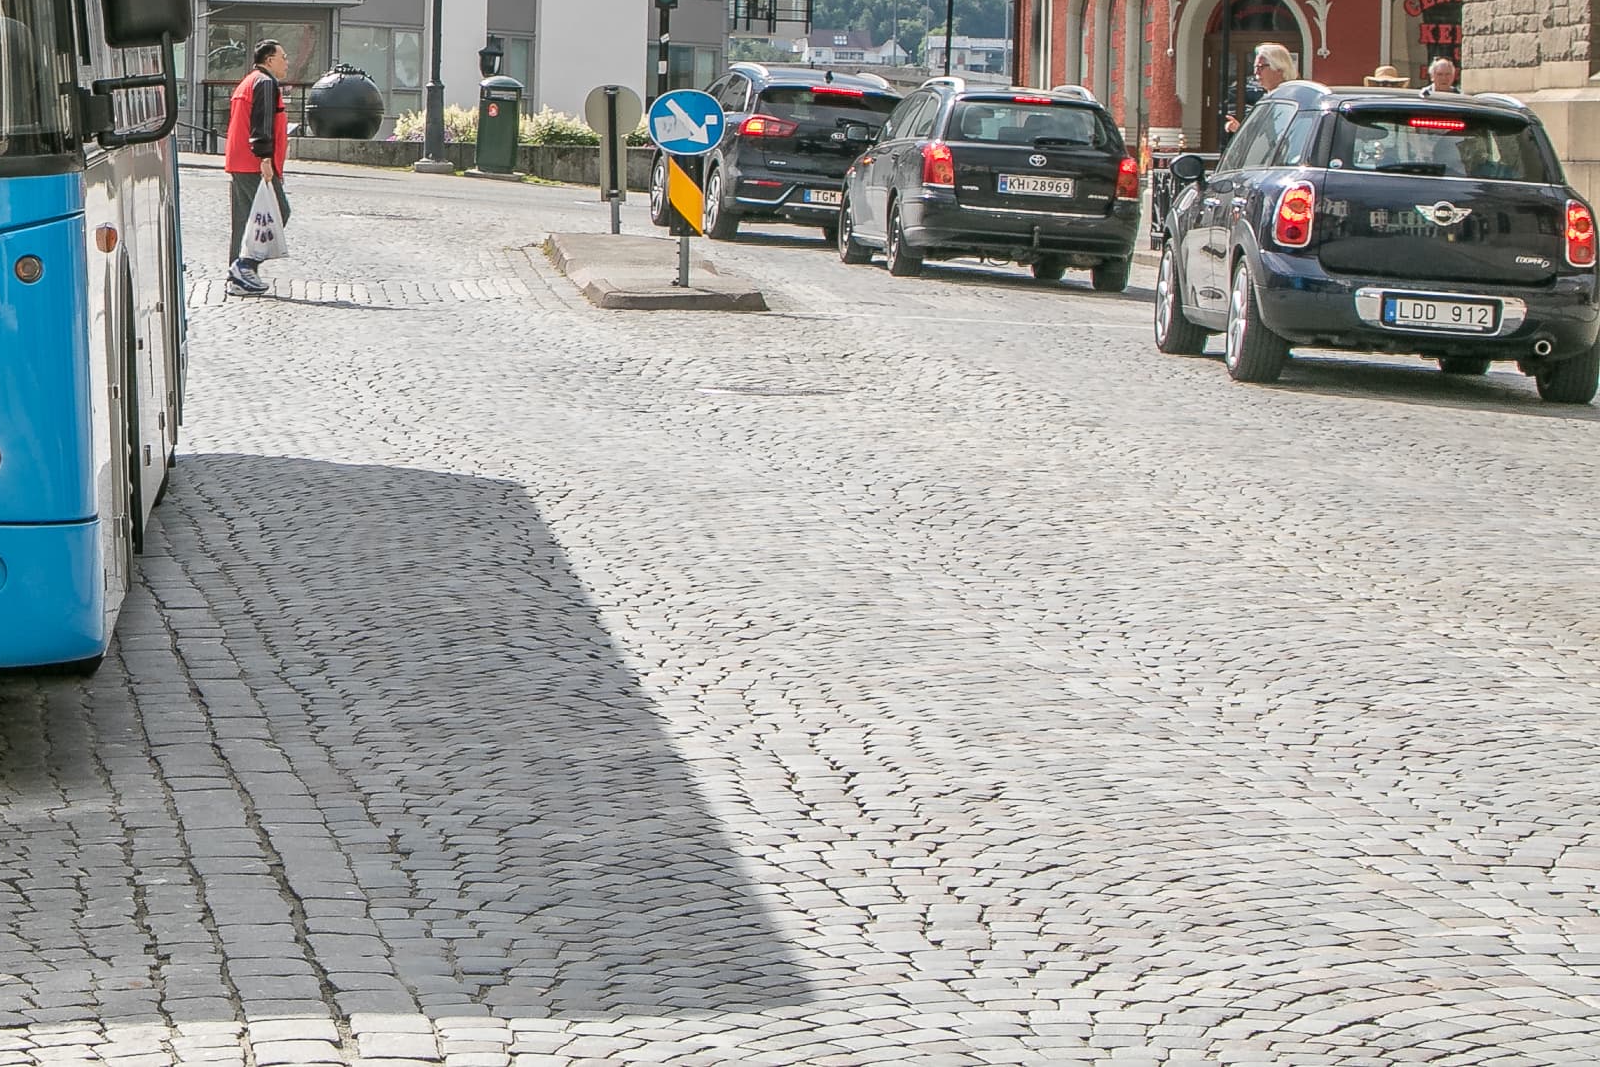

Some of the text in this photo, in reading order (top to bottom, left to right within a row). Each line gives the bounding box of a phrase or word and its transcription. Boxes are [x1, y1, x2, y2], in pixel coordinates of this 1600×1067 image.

[1008, 177, 1071, 193] KH 28969
[815, 190, 838, 203] TGM
[1399, 301, 1489, 325] LDD 912
